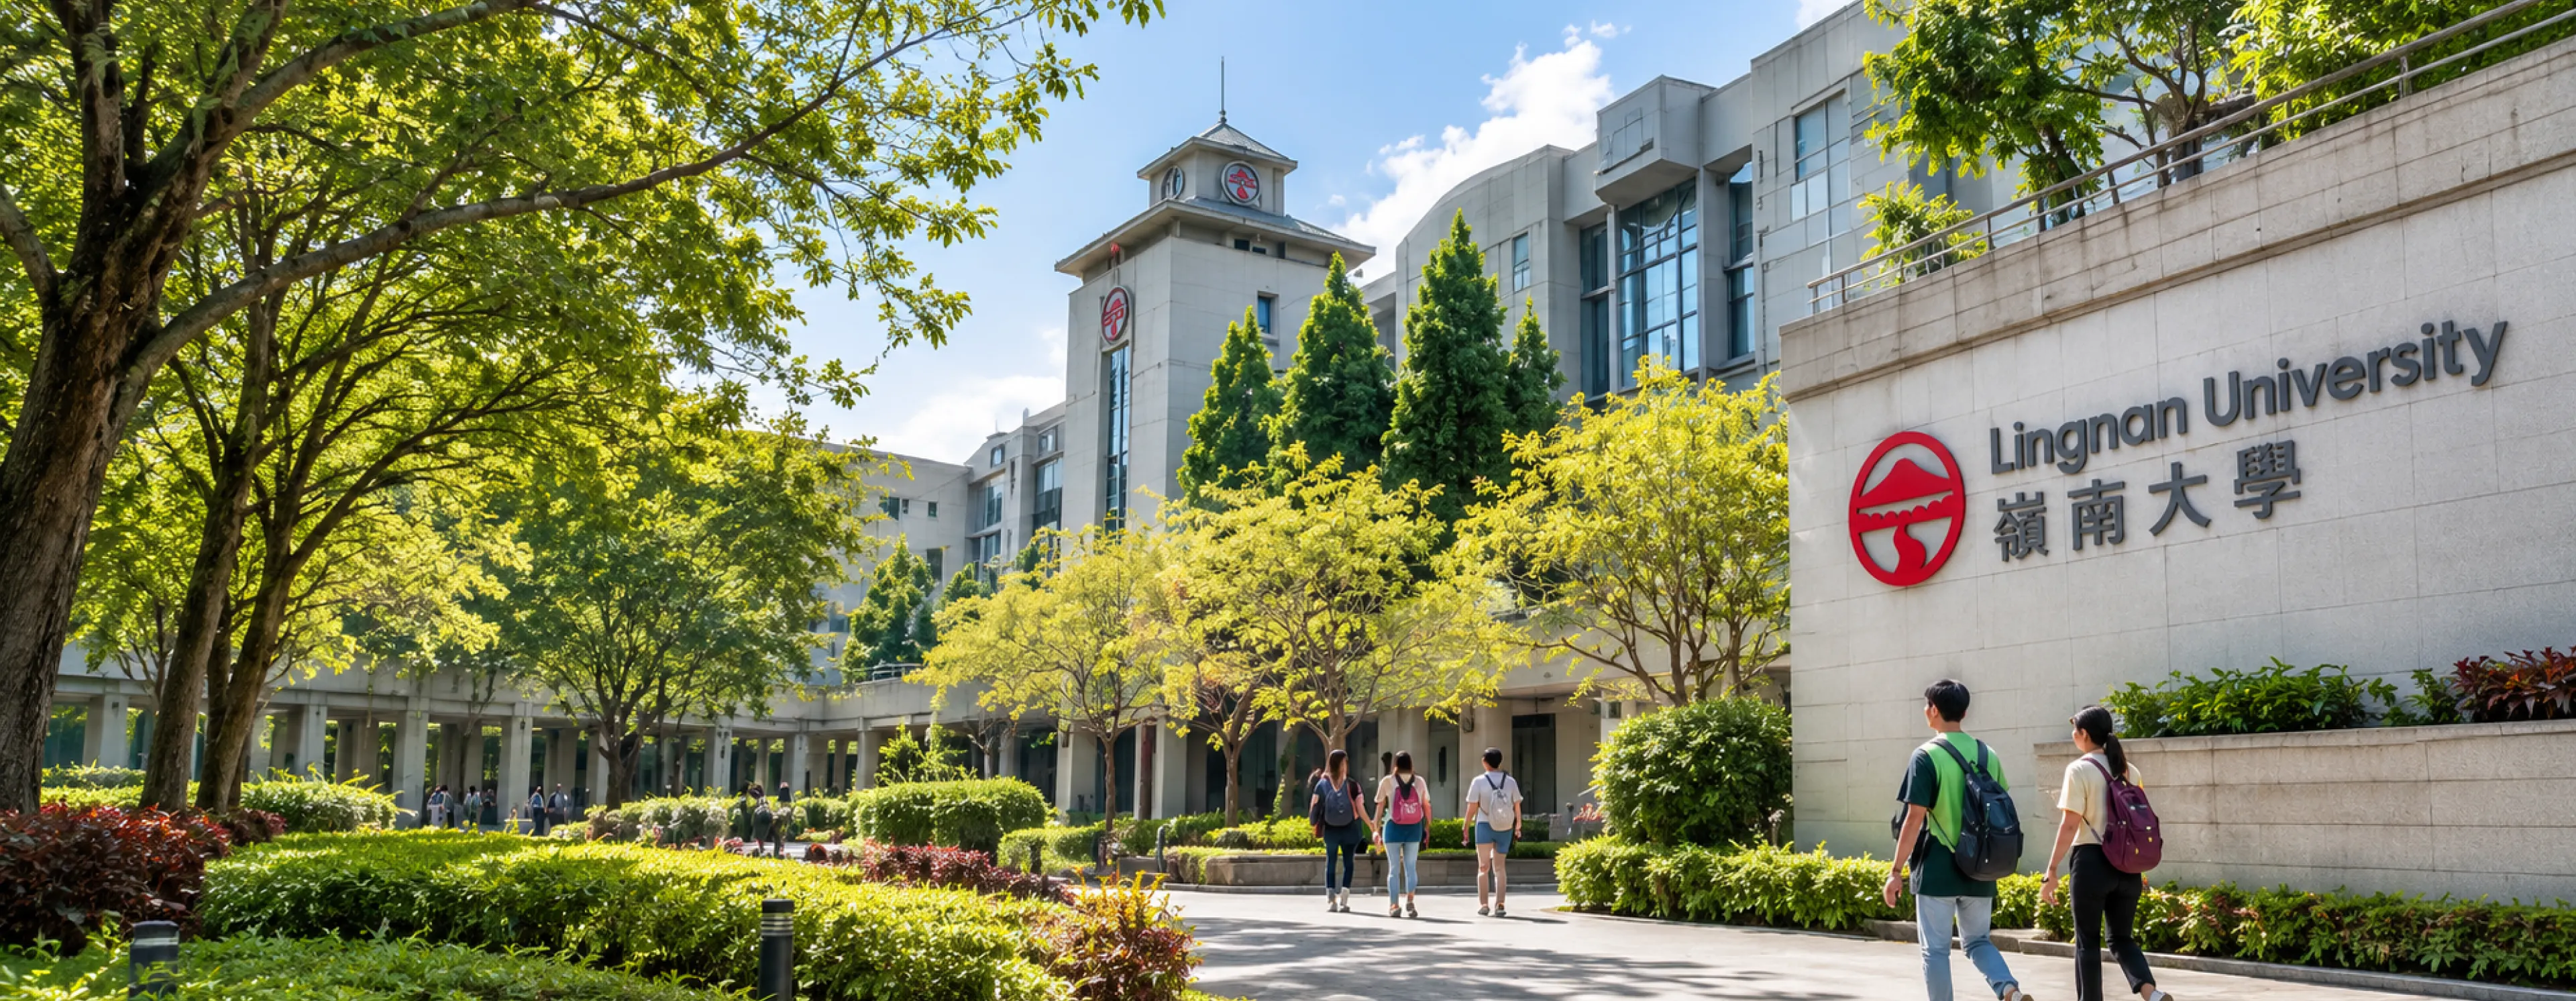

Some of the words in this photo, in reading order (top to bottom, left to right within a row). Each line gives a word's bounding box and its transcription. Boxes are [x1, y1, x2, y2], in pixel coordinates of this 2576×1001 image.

[1990, 397, 2189, 476] Lingnan
[2203, 320, 2509, 428] University
[1993, 439, 2302, 563] 嶺南大學
